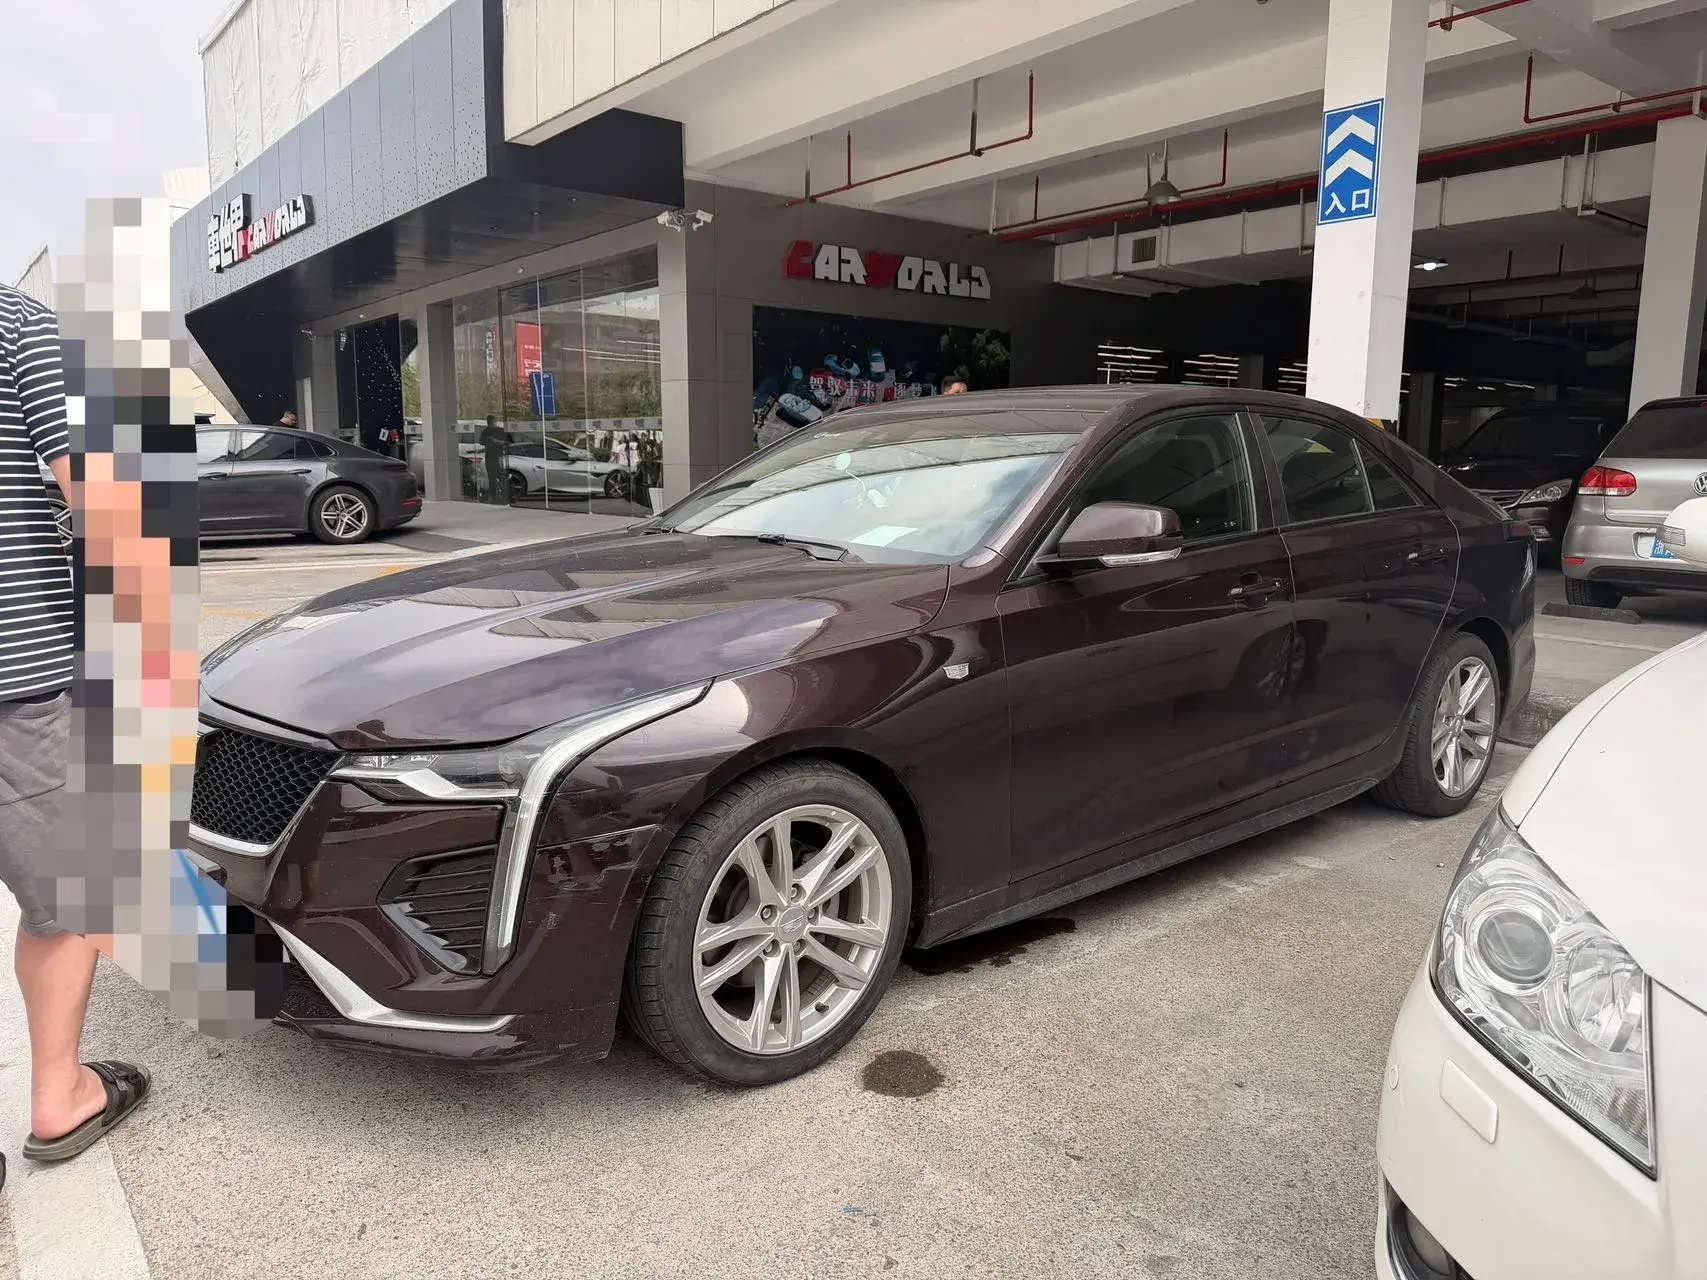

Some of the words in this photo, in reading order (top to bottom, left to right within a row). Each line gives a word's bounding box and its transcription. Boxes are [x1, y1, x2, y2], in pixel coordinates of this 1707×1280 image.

[1325, 188, 1370, 216] 入口
[809, 376, 875, 397] 驾驭未来
